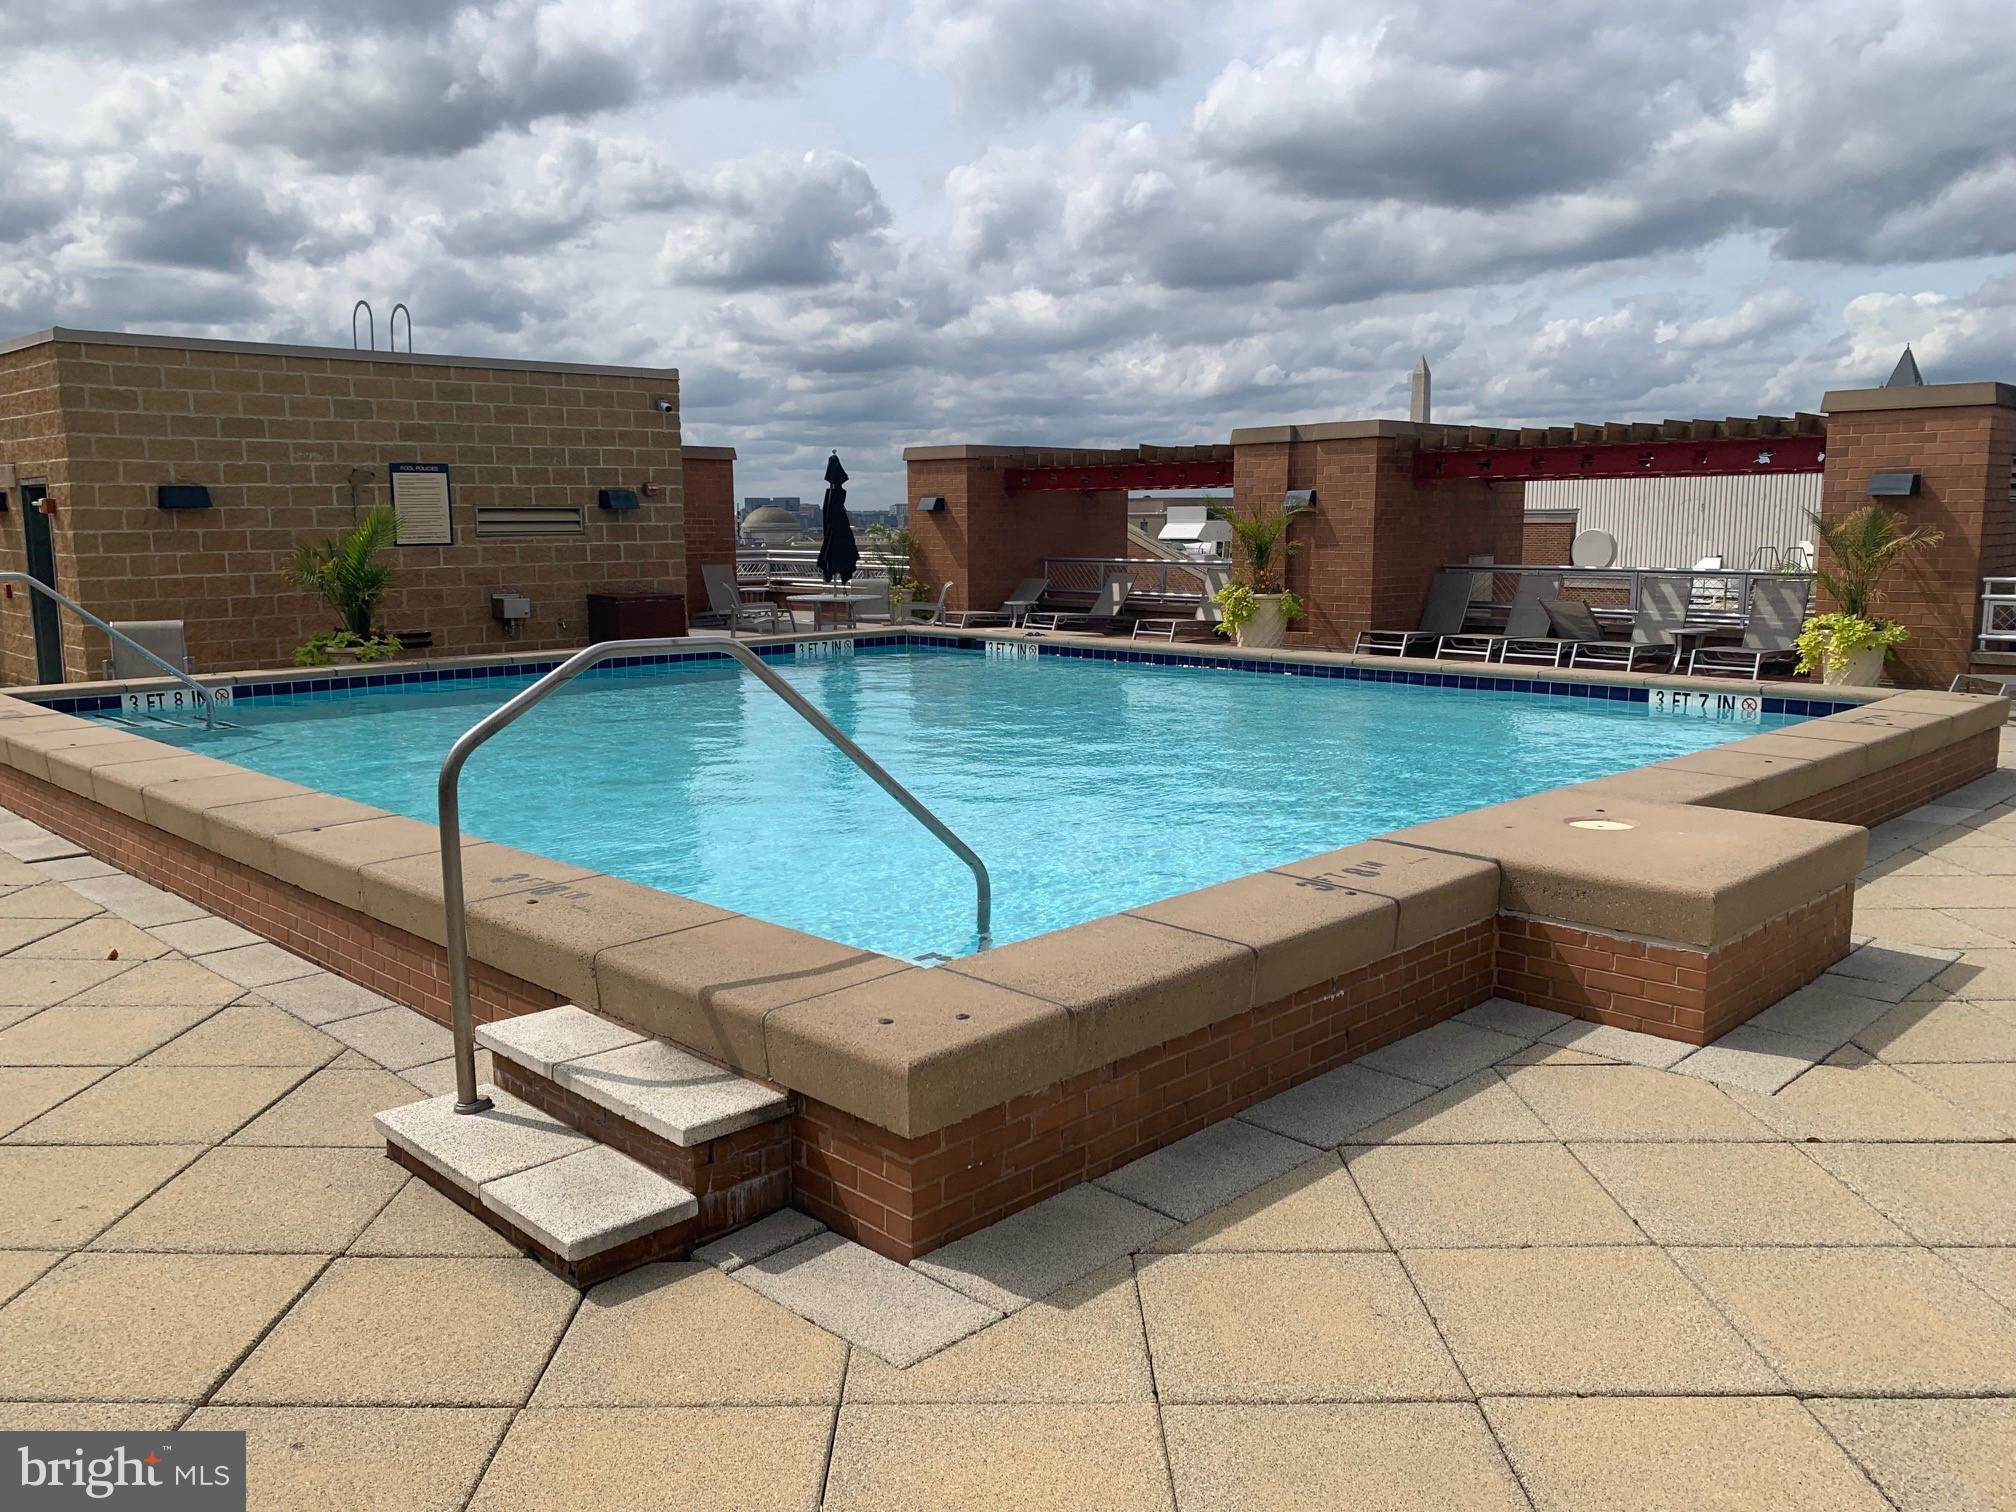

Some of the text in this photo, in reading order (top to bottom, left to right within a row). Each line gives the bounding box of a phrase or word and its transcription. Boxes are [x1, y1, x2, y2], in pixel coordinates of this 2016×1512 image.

[808, 643, 818, 654] FT
[832, 641, 841, 653] IN
[997, 643, 1005, 654] FT
[1018, 644, 1026, 656] IN
[129, 695, 138, 708] 3
[174, 692, 183, 706] 8
[1672, 691, 1691, 707] FT
[1698, 693, 1710, 708] 7
[1717, 694, 1736, 710] IN
